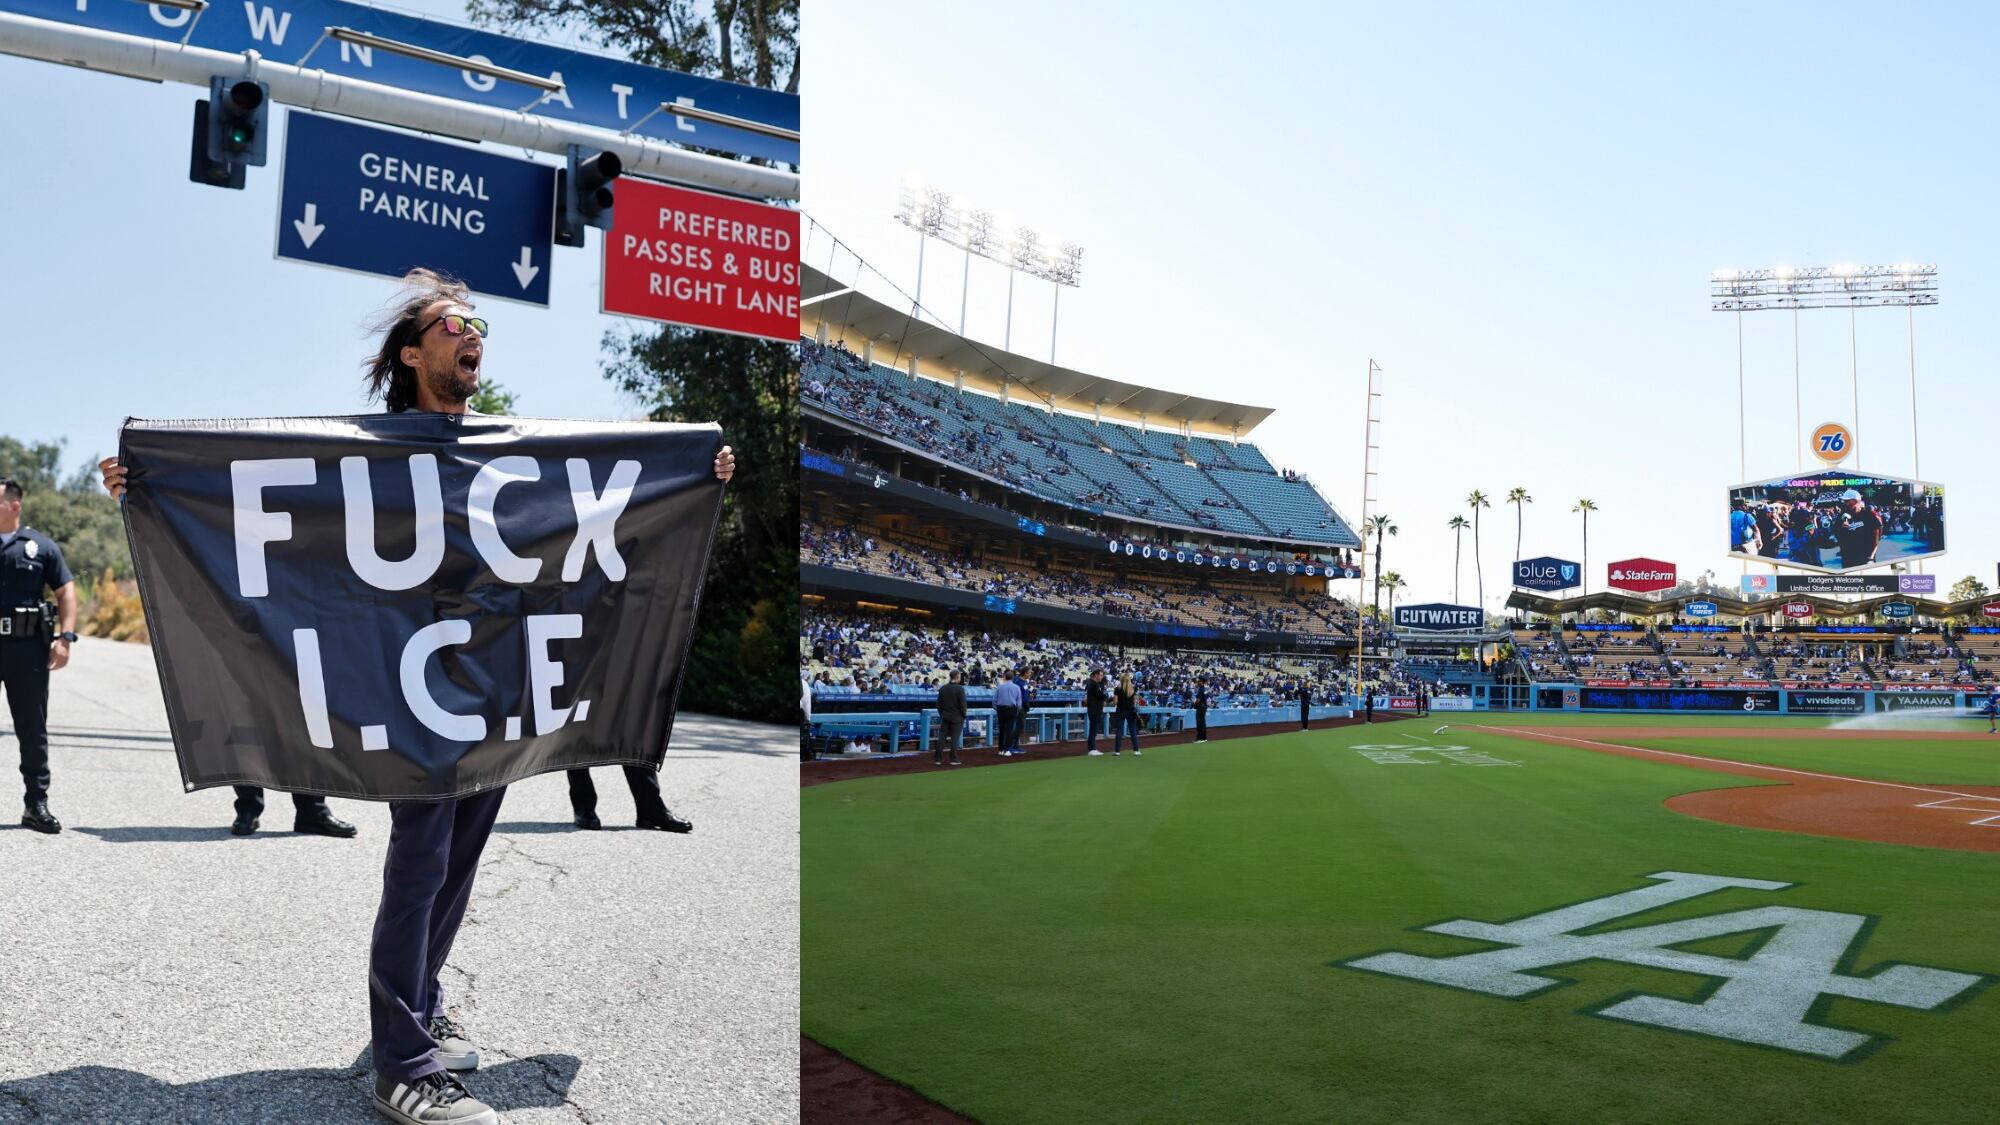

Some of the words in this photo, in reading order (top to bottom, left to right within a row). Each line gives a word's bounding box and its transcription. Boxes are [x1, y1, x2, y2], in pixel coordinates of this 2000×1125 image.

[360, 152, 490, 201] GENERAL
[360, 187, 486, 234] PARKING
[659, 207, 791, 252] PREFERRED
[624, 234, 713, 271] PASSES
[722, 252, 739, 276] &
[650, 272, 727, 306] RIGHT
[1819, 432, 1845, 452] 76
[1820, 479, 1845, 487] PRIDE
[1846, 478, 1873, 486] NIGHT
[1306, 566, 1314, 574] 53
[1519, 563, 1557, 578] blue
[1625, 570, 1650, 581] State
[1650, 570, 1674, 581] Farm
[1525, 578, 1561, 586] california
[1808, 576, 1834, 584] Dodgers
[1835, 576, 1864, 584] Welcome
[1833, 585, 1864, 593] Attorney's
[1401, 609, 1478, 624] CUTWATER
[293, 613, 590, 751] I.C.E.
[1566, 694, 1577, 704] 76
[1806, 696, 1856, 705] vividseats
